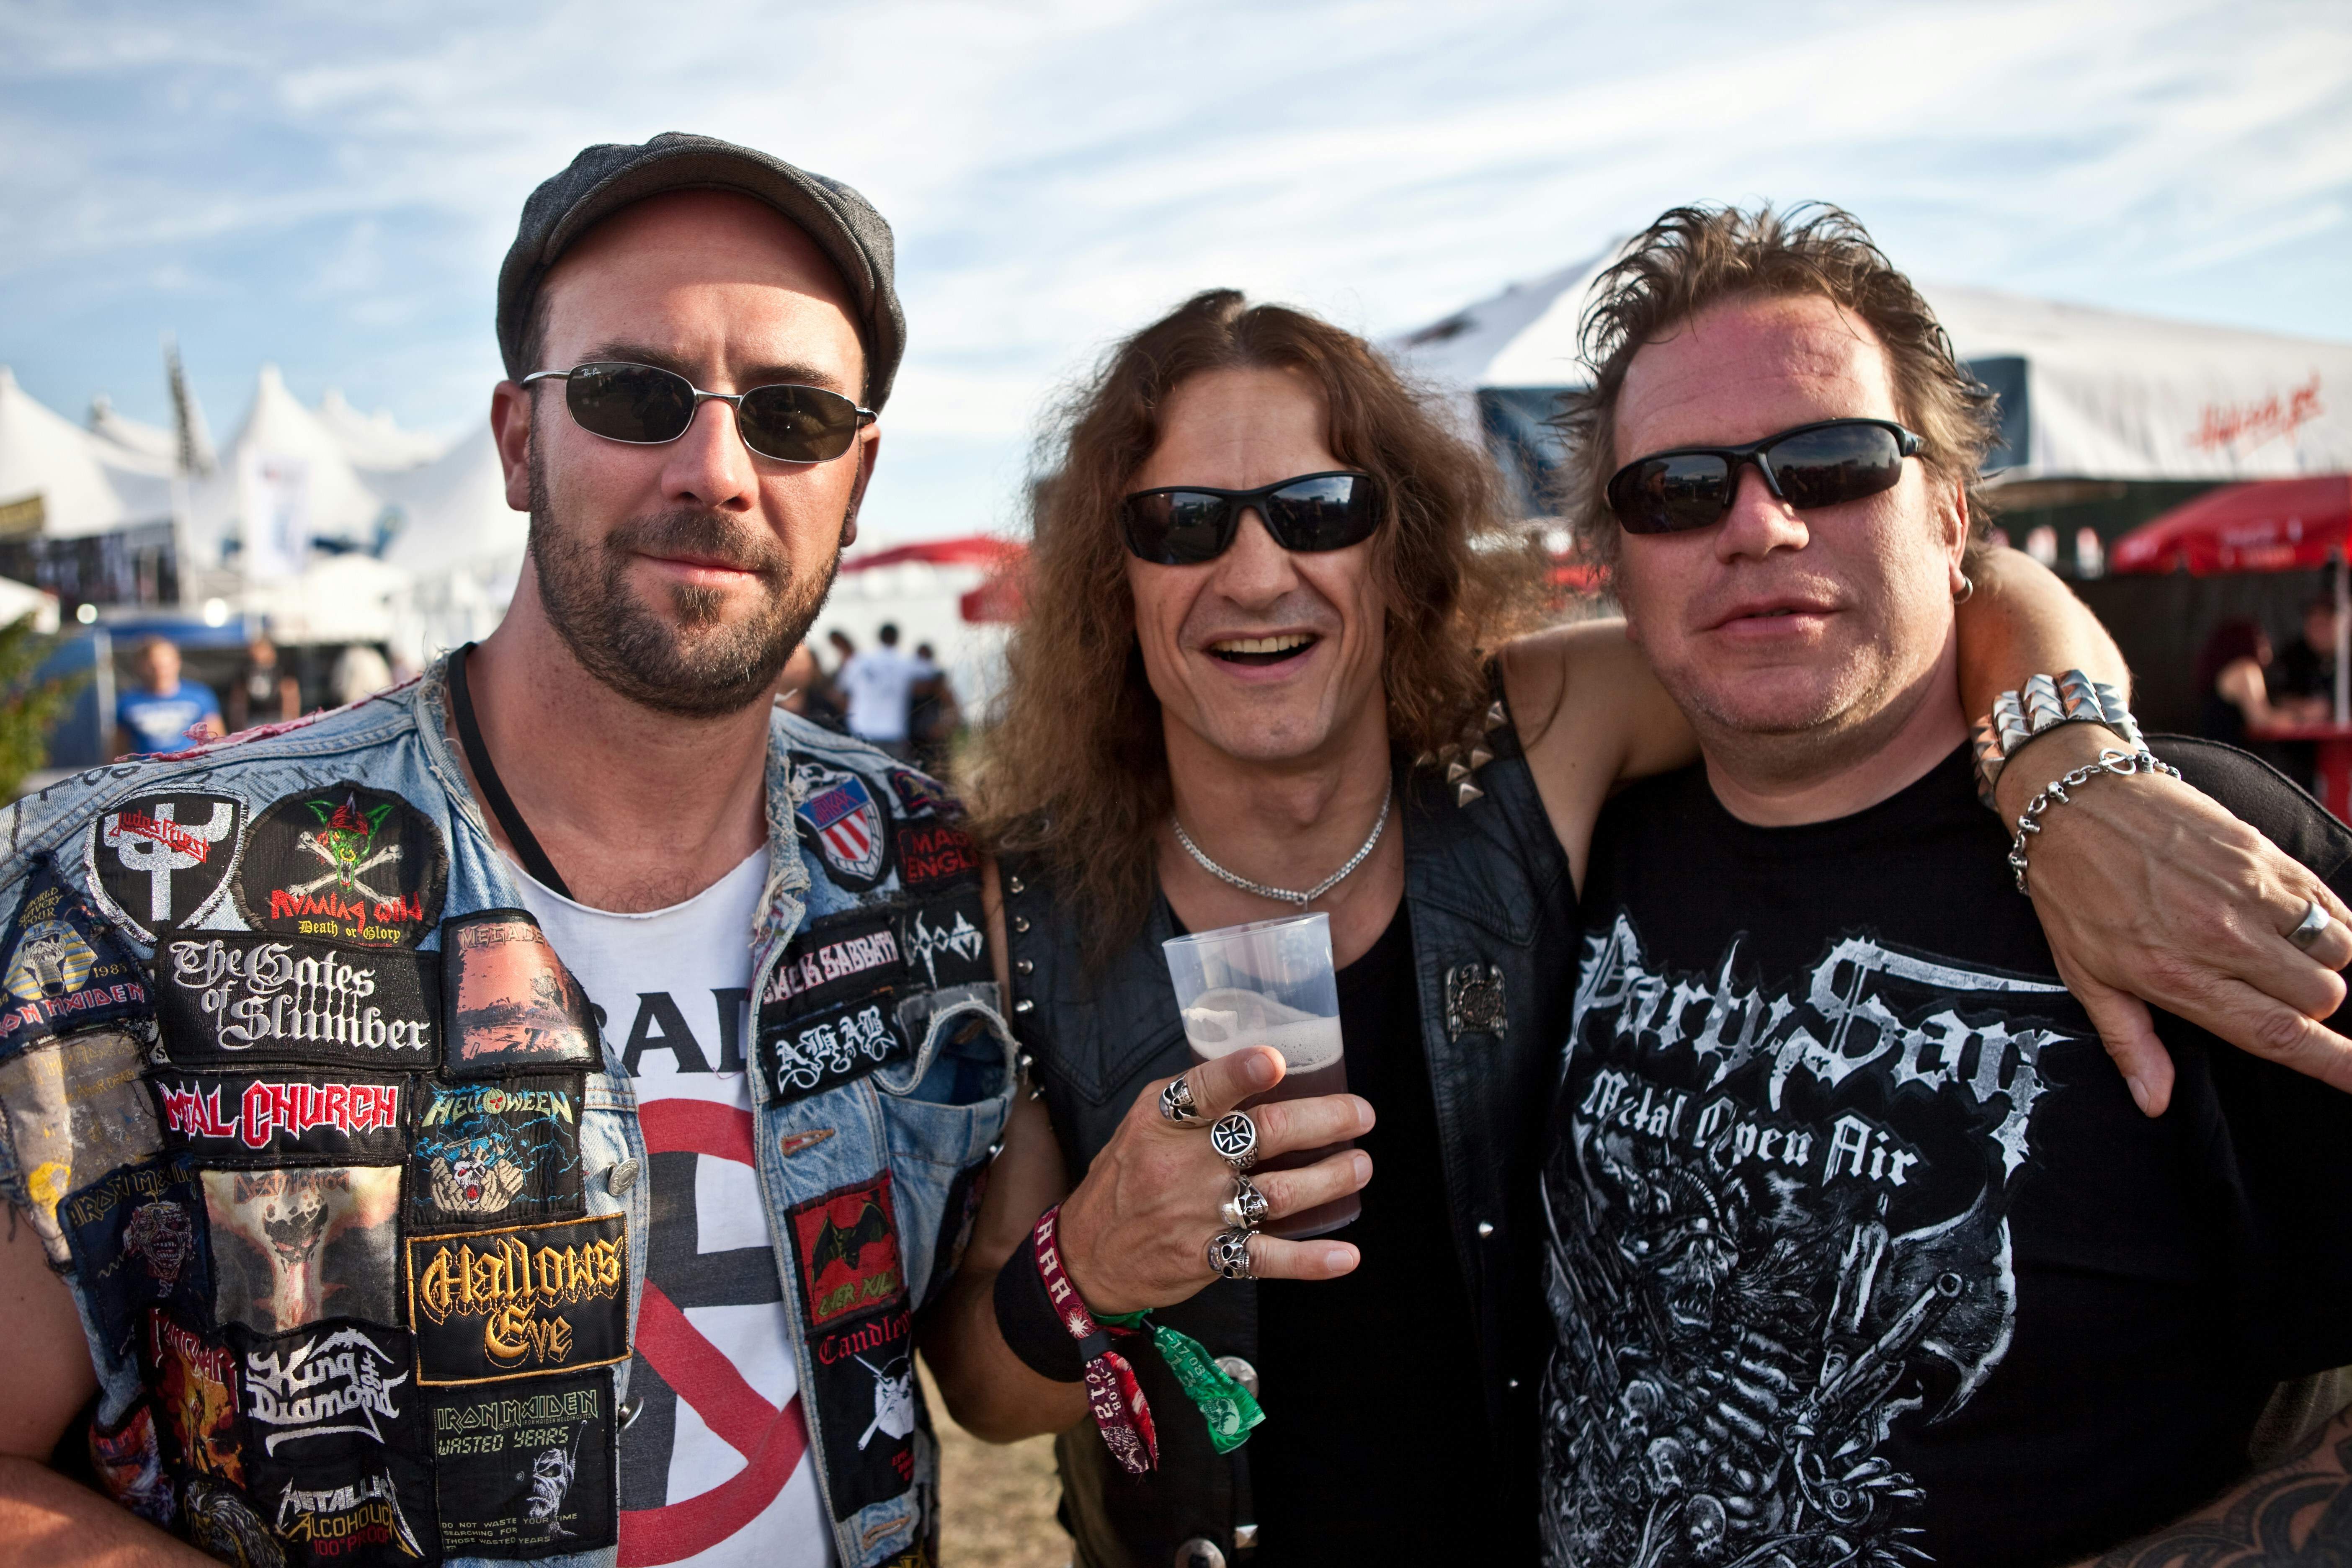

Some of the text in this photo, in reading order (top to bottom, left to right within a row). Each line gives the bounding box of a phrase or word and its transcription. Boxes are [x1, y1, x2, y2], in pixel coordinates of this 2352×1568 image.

[581, 367, 601, 378] Ray-Ban
[109, 809, 211, 864] Judas Priest
[18, 895, 64, 927] SLAVERY
[23, 907, 57, 929] TOUR
[24, 887, 59, 911] WORLD
[298, 920, 401, 943] Death or Glory
[169, 940, 375, 998] The Gates
[819, 930, 900, 982] SABBATH
[41, 983, 145, 1017] MAIDEN
[201, 980, 238, 1032] of
[218, 994, 431, 1051] Slumber
[242, 1079, 400, 1149] CHURCH
[421, 1086, 574, 1127] HELLOWEEN
[1821, 1114, 1920, 1187] Air
[420, 1235, 623, 1326] Hallows
[484, 1300, 573, 1369] Eve
[245, 1369, 410, 1441] Diamond
[437, 1389, 598, 1435] IRON MAIDEN
[536, 1416, 557, 1425] MAIDEN
[557, 1414, 583, 1424] HOLDINGS
[438, 1426, 570, 1456] WASTED YEARS
[479, 1536, 516, 1545] WASTED
[518, 1536, 551, 1544] YEARS
[484, 1517, 517, 1528] WASTE
[554, 1513, 578, 1521] TIME
